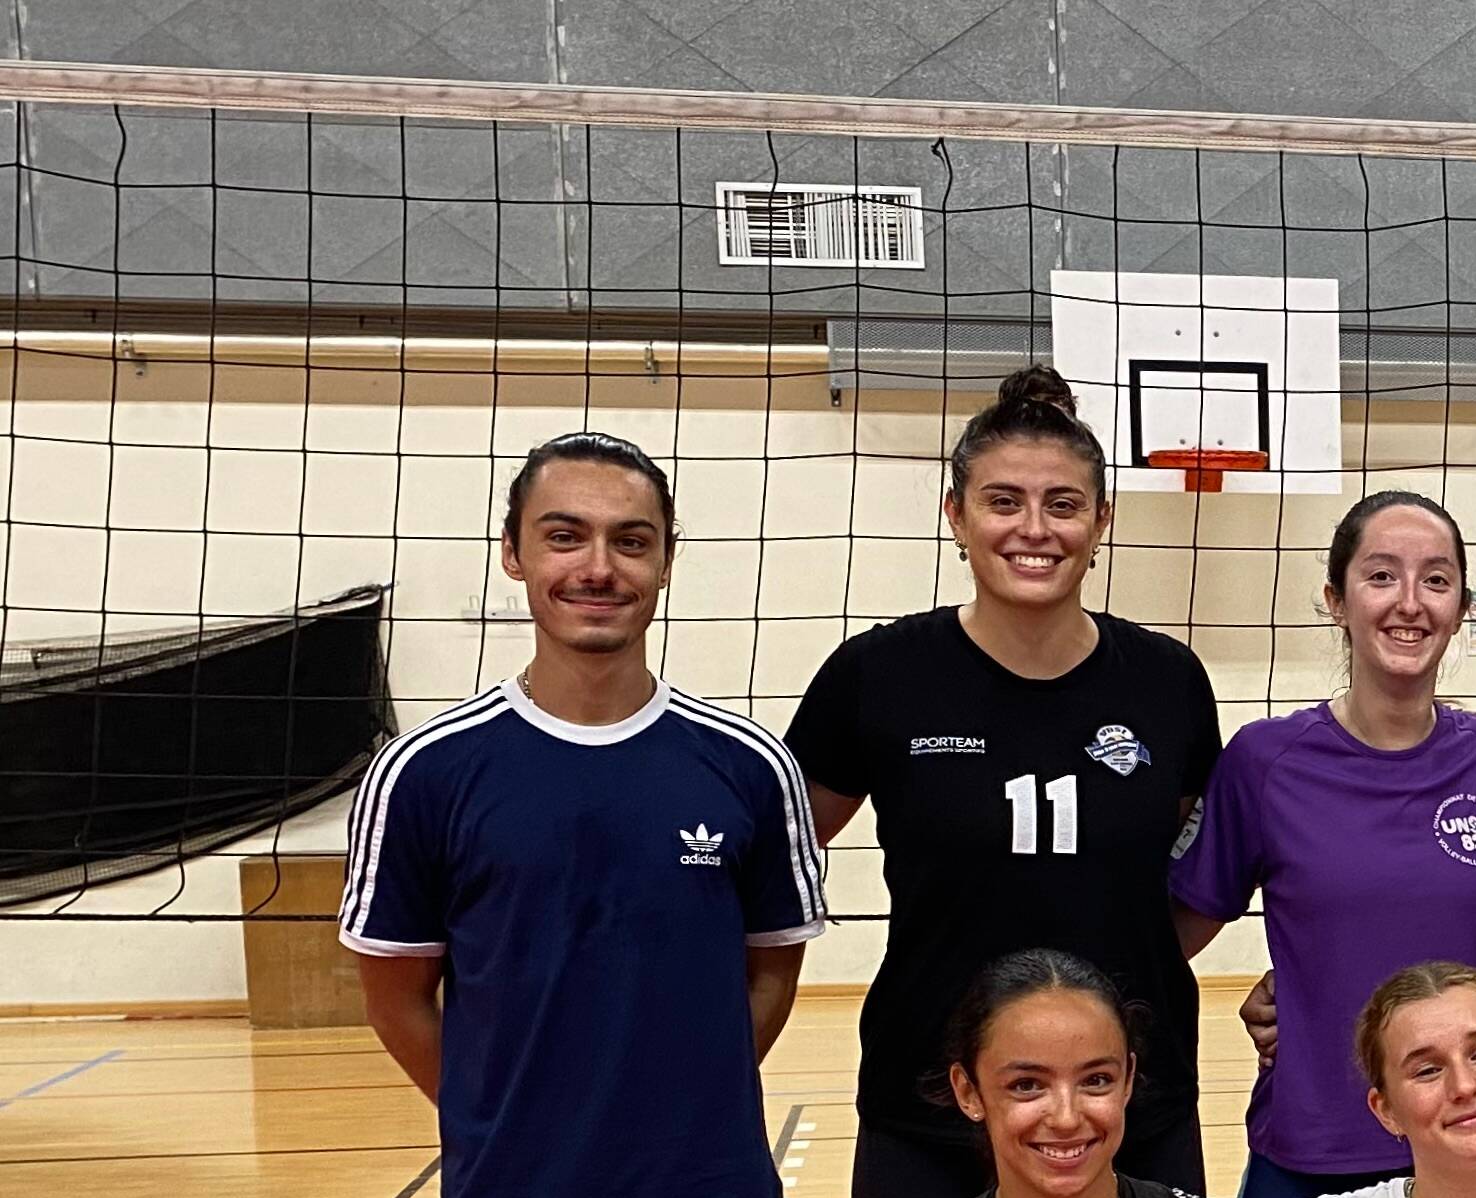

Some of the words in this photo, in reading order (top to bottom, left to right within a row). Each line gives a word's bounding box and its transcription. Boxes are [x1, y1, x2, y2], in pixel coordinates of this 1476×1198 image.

[911, 736, 985, 749] SPORTEAM
[1005, 774, 1077, 854] 11
[680, 853, 721, 866] adidas
